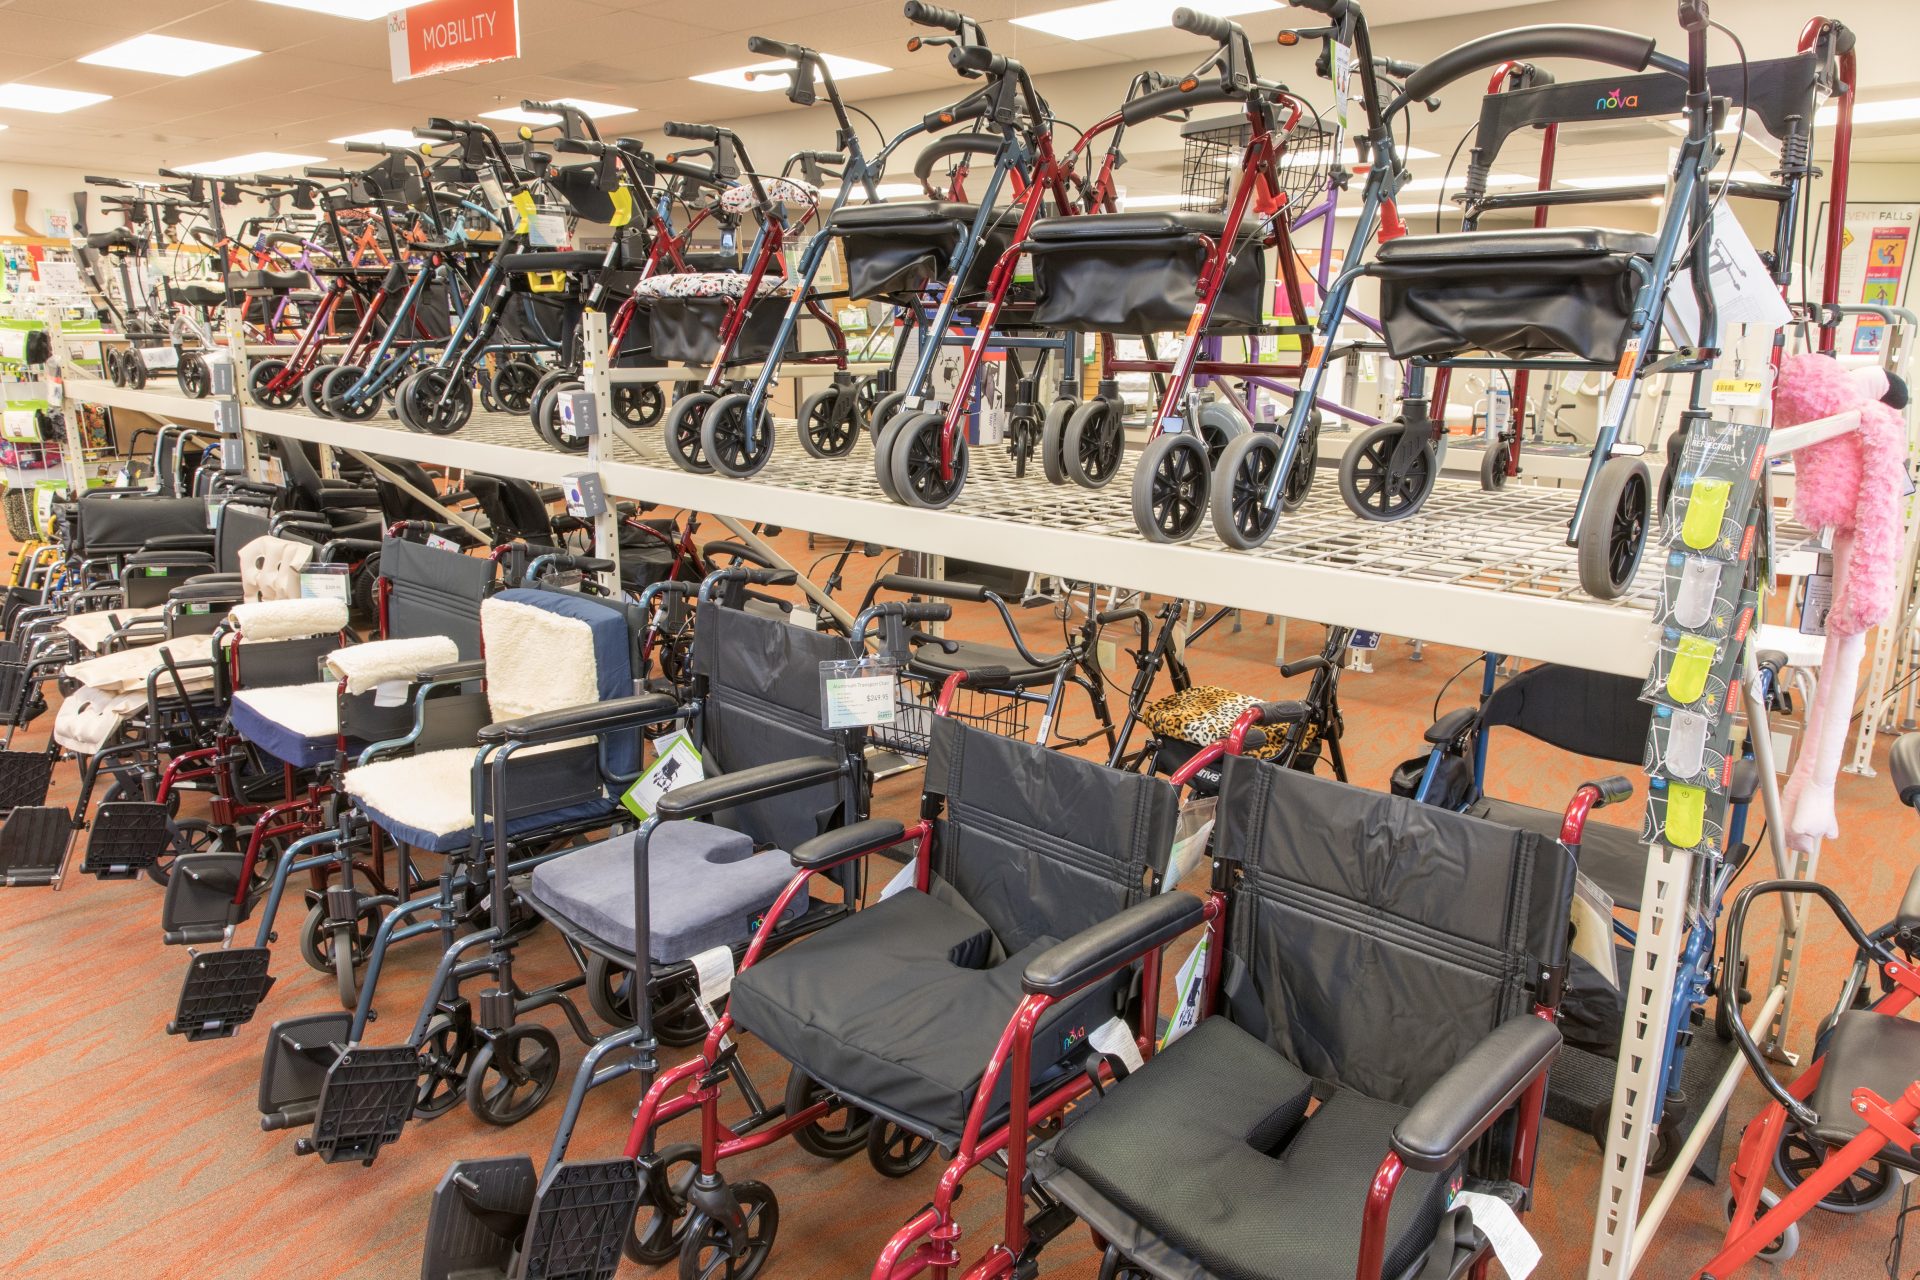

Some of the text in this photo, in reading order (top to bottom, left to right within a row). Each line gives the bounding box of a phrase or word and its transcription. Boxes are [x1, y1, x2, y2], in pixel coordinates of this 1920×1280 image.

[423, 11, 496, 51] MOBILITY
[1596, 94, 1639, 110] nova
[1880, 211, 1912, 220] FALLS
[1064, 1026, 1085, 1050] nova
